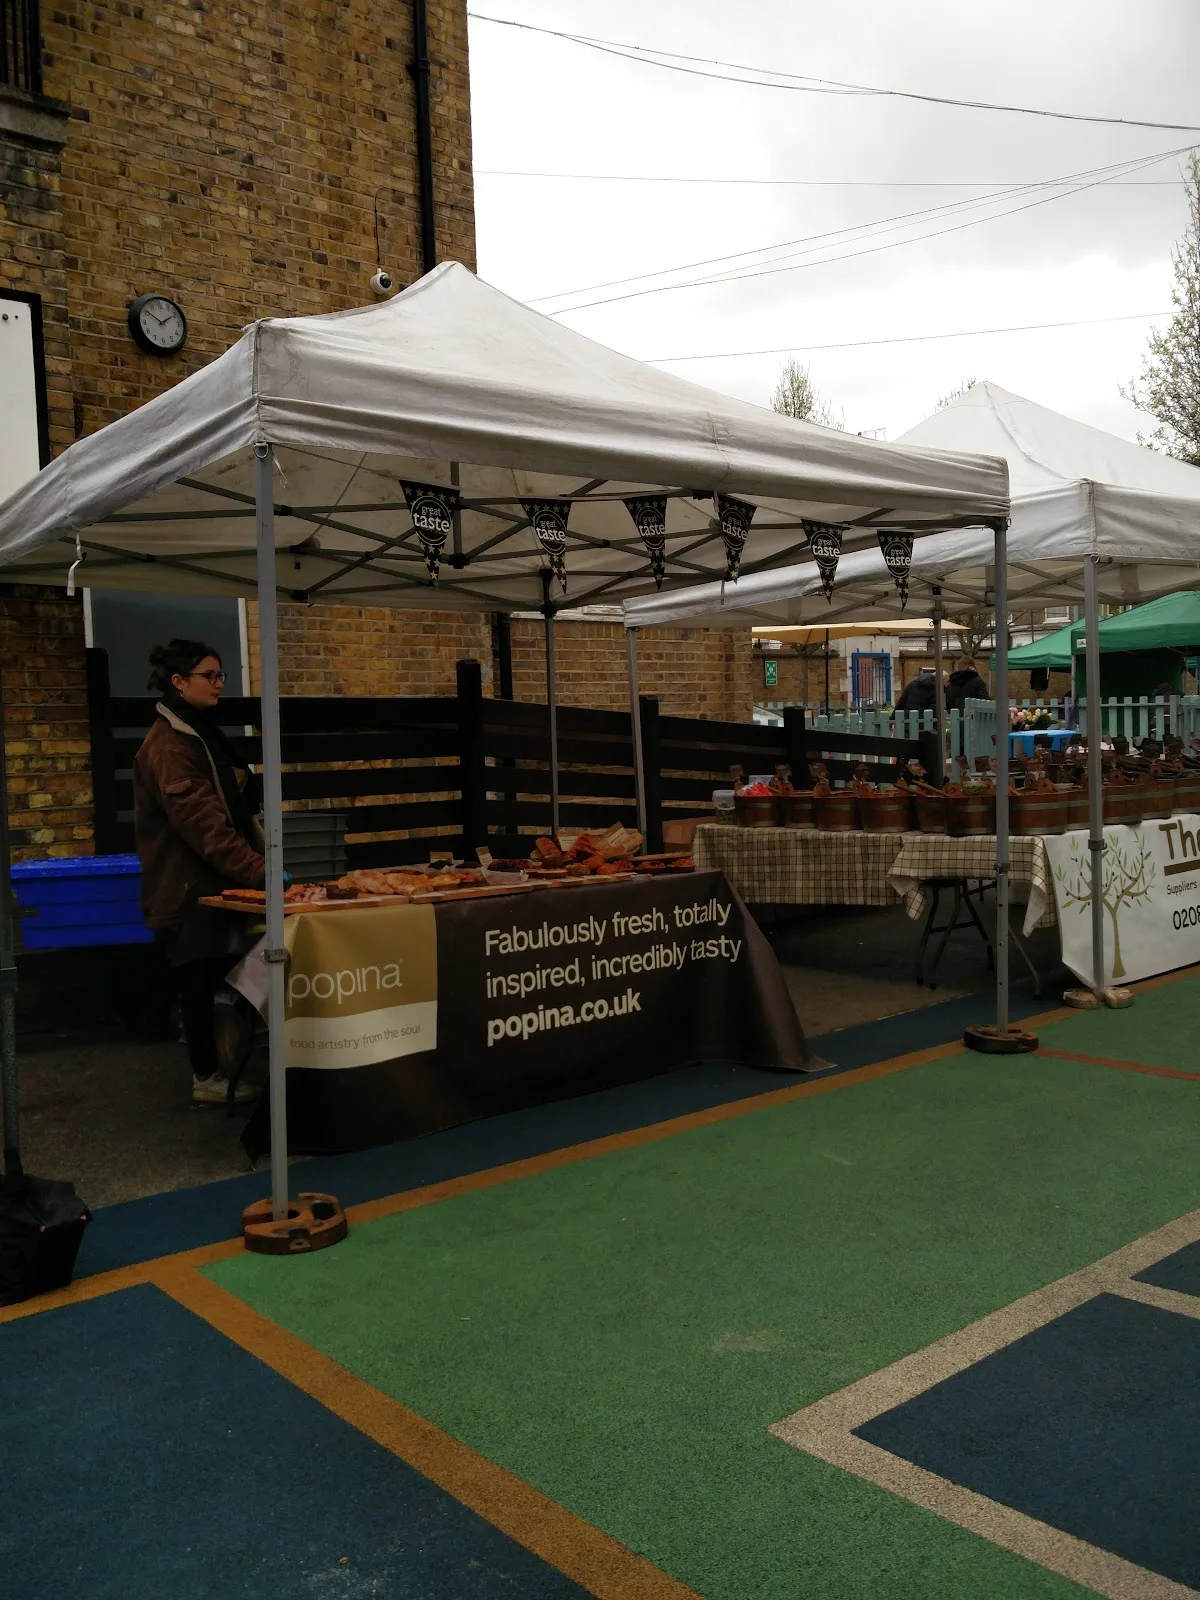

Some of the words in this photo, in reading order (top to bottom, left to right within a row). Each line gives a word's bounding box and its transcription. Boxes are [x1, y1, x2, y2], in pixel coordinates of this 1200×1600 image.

[421, 506, 442, 517] great
[413, 512, 450, 532] taste
[539, 520, 557, 529] great
[642, 516, 658, 525] great
[727, 516, 743, 526] great
[535, 527, 567, 541] taste
[638, 523, 666, 536] taste
[722, 521, 748, 540] taste
[817, 538, 833, 546] great
[812, 545, 840, 557] taste
[890, 548, 905, 556] great
[885, 556, 911, 566] taste
[1166, 880, 1197, 896] Suppliers
[485, 915, 607, 957] Fabulously
[612, 903, 669, 937] fresh,
[673, 897, 732, 928] totally
[486, 957, 587, 999] inspired,
[591, 941, 689, 981] incredibly
[690, 935, 742, 963] tasty
[288, 963, 404, 1008] popina
[487, 988, 642, 1047] popina.co.uk
[290, 1038, 315, 1049] food
[317, 1038, 360, 1049] artistry
[362, 1032, 383, 1045] from
[384, 1028, 398, 1040] the
[400, 1025, 421, 1036] soul
